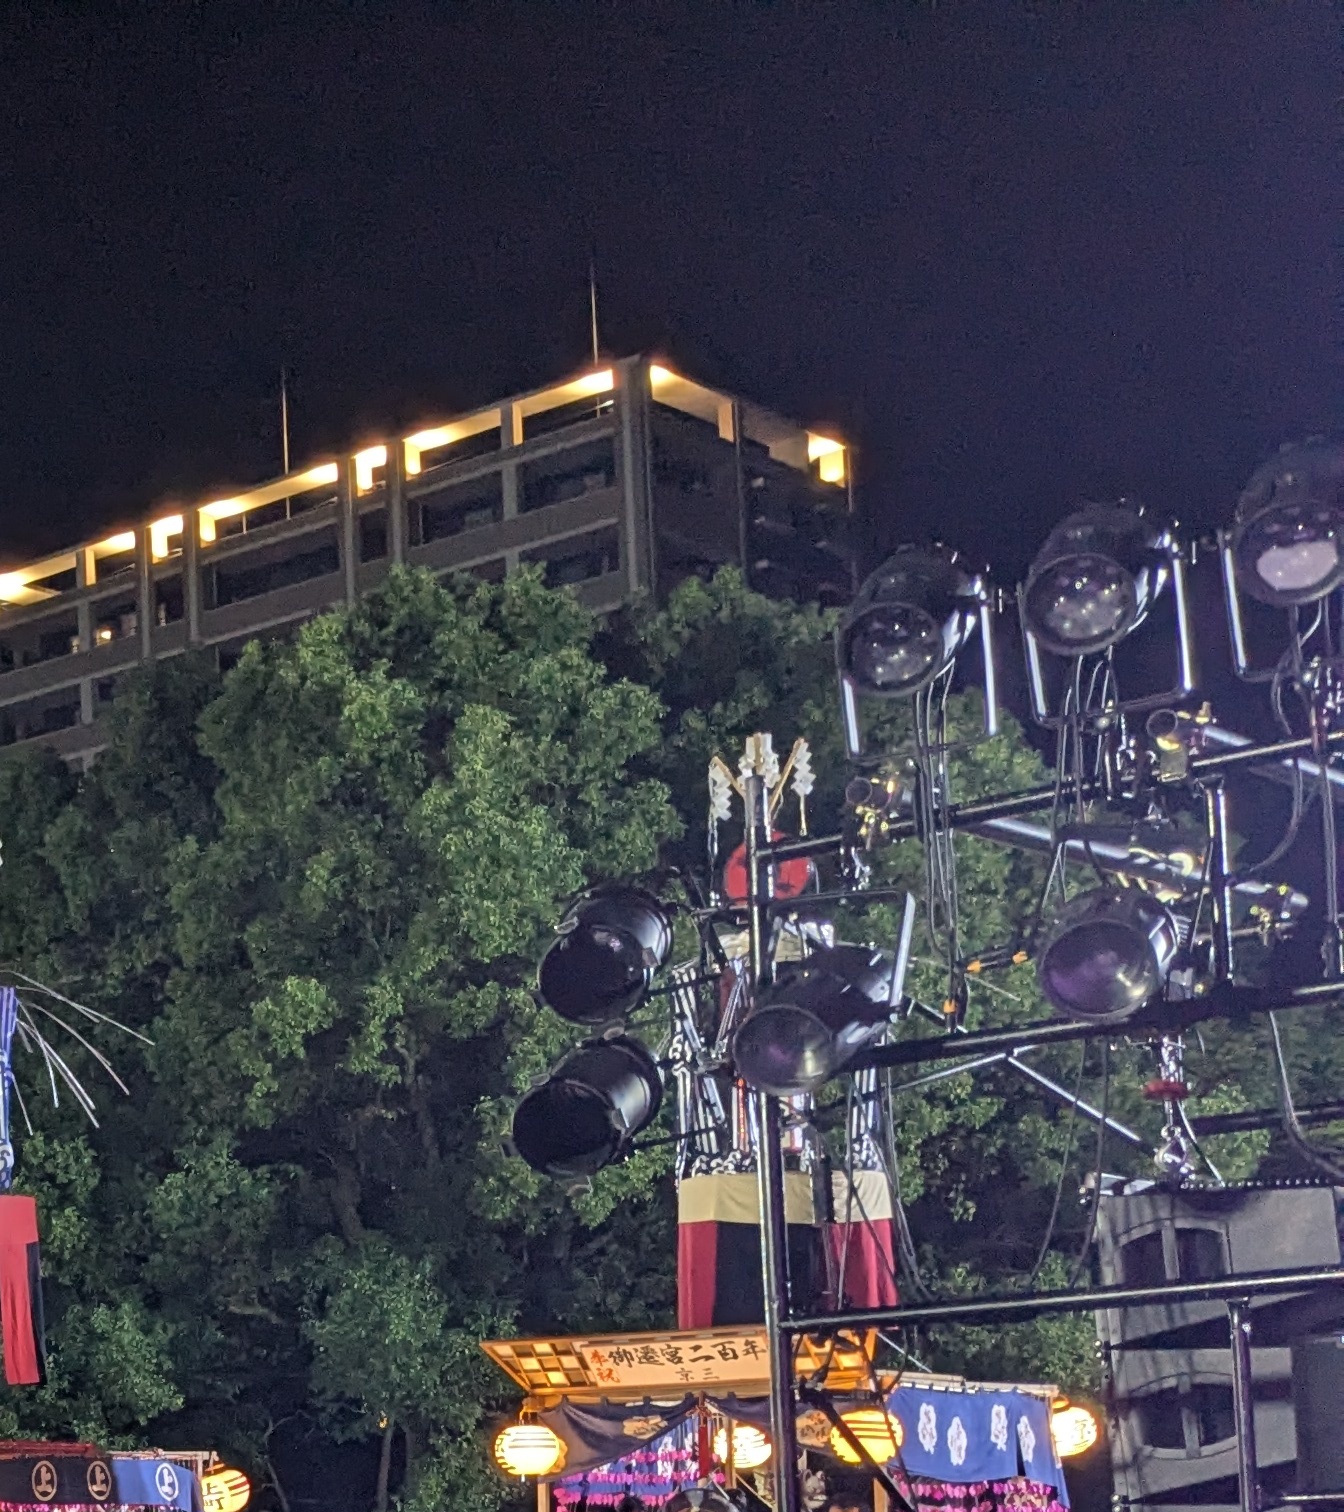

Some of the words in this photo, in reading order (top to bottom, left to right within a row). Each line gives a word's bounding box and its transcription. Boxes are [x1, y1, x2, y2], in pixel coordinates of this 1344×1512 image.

[36, 1466, 54, 1493] 上
[91, 1466, 109, 1493] 上
[161, 1467, 176, 1494] 上
